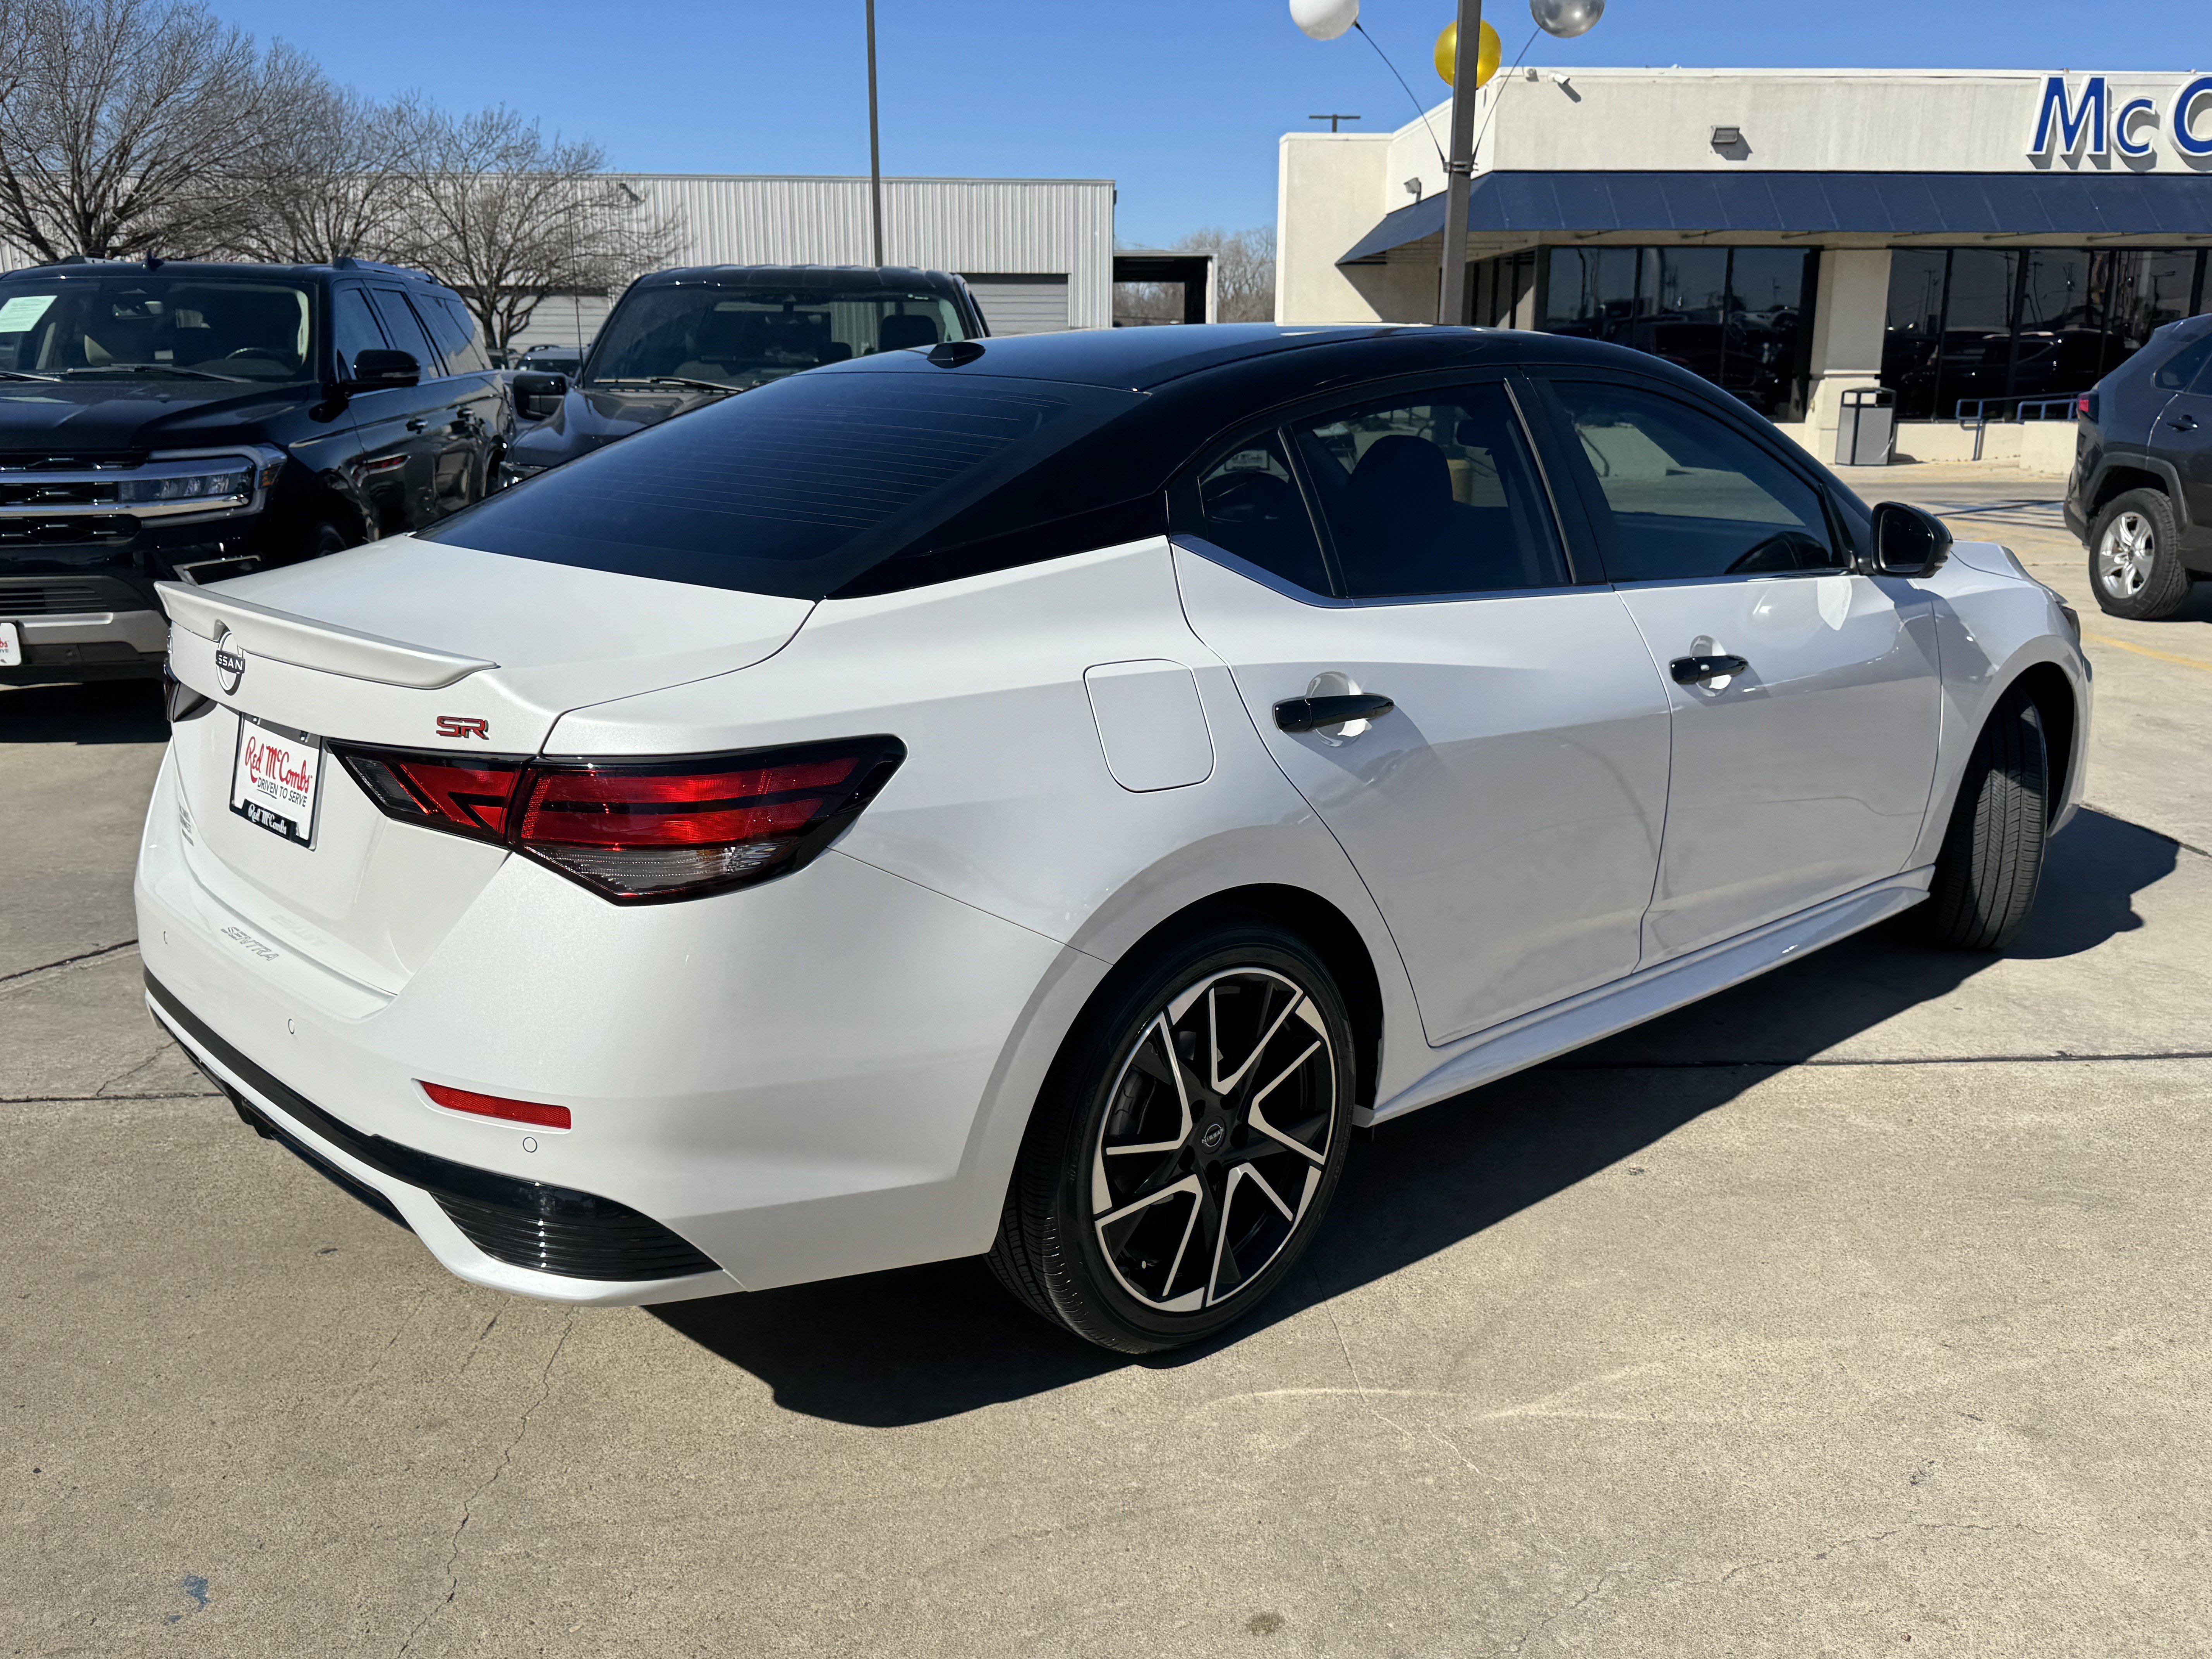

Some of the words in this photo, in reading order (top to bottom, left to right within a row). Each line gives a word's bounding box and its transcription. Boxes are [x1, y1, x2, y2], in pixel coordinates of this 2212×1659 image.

[436, 716, 489, 740] SR
[245, 736, 264, 783] Red
[266, 745, 310, 793] McCombs
[257, 777, 278, 795] DRIVEN
[280, 786, 288, 799] TO
[289, 790, 307, 807] SERVE
[248, 804, 261, 823] Red
[261, 809, 287, 835] McCombs
[220, 927, 279, 961] SENTRA
